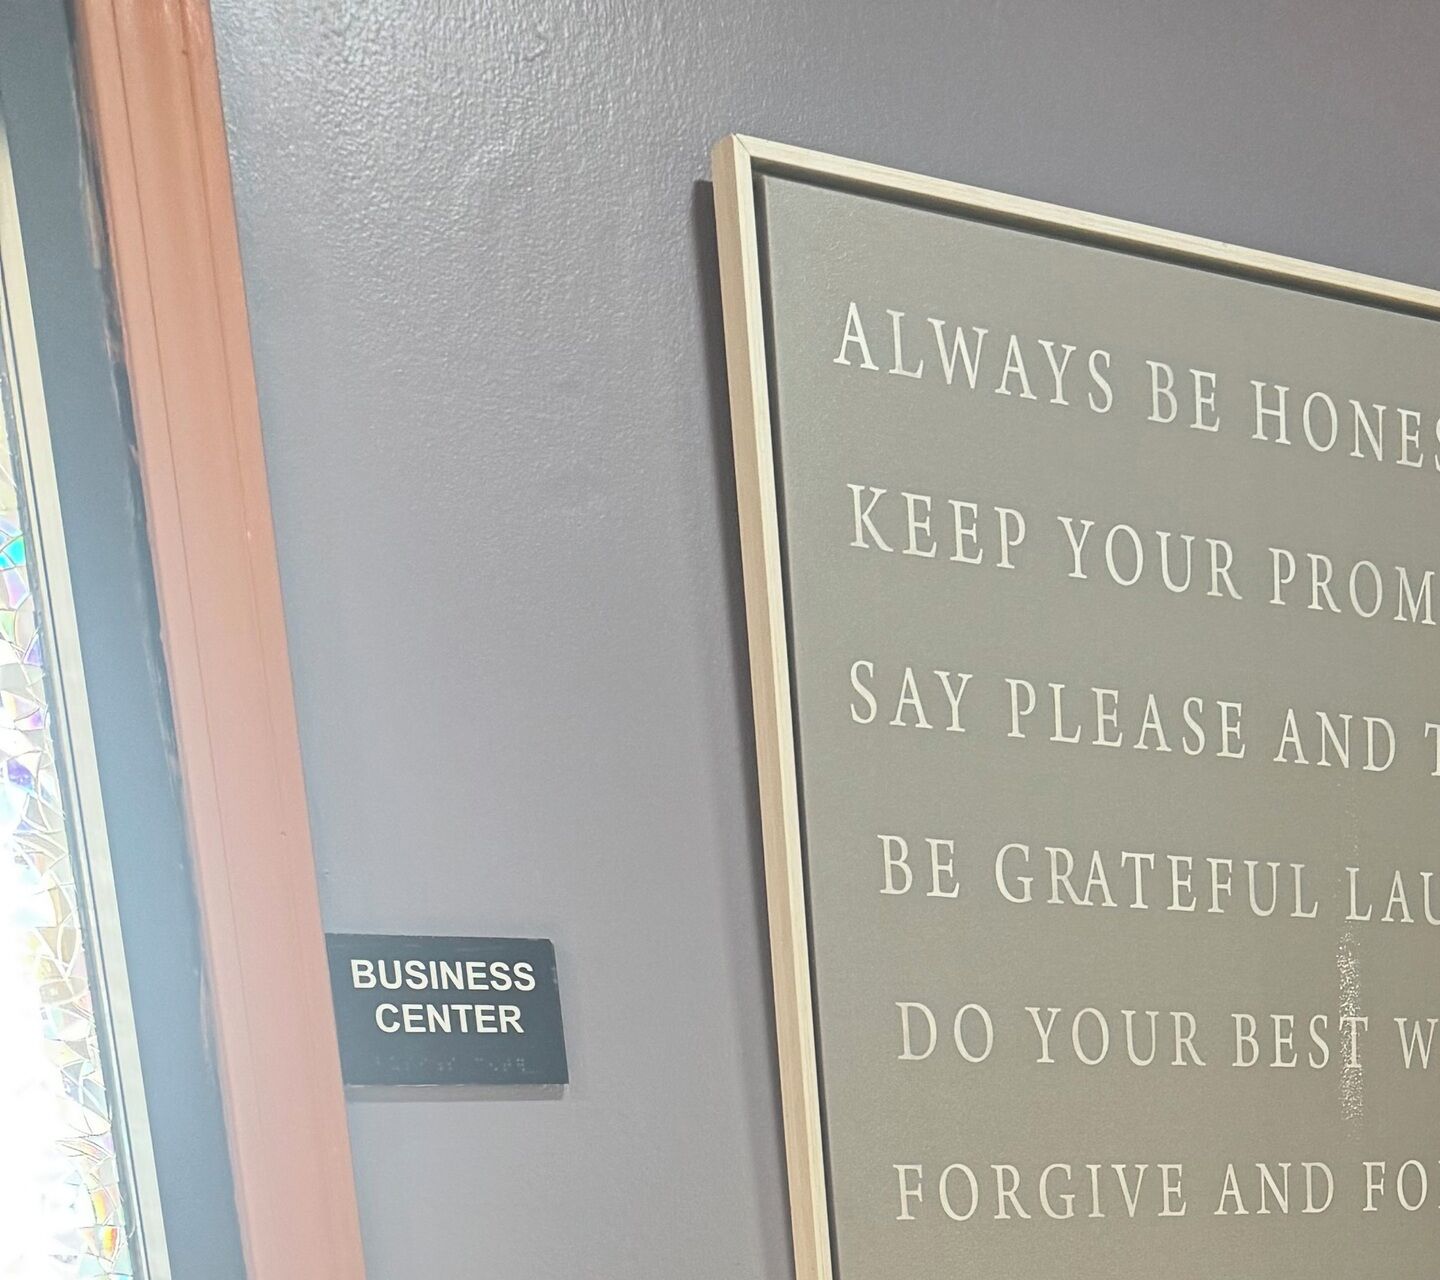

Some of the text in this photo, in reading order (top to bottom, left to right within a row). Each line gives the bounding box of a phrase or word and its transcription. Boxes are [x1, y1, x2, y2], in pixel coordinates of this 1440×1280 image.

[833, 301, 1113, 413] ALWAYS
[1146, 360, 1220, 432] BE
[847, 484, 1025, 569] KEEP
[1057, 516, 1243, 600] YOUR
[850, 660, 973, 732] SAY
[1005, 678, 1245, 758] PLEASE
[1273, 708, 1395, 771] AND
[877, 835, 960, 898] BE
[995, 843, 1318, 918] GRATEFUL
[350, 959, 536, 991] BUSINESS
[375, 1003, 525, 1034] CENTER
[895, 1002, 993, 1063] DO
[1025, 1007, 1206, 1066] YOUR
[1232, 1012, 1368, 1070] BEST
[893, 1164, 1186, 1221] FORGIVE
[1213, 1162, 1334, 1215] AND
